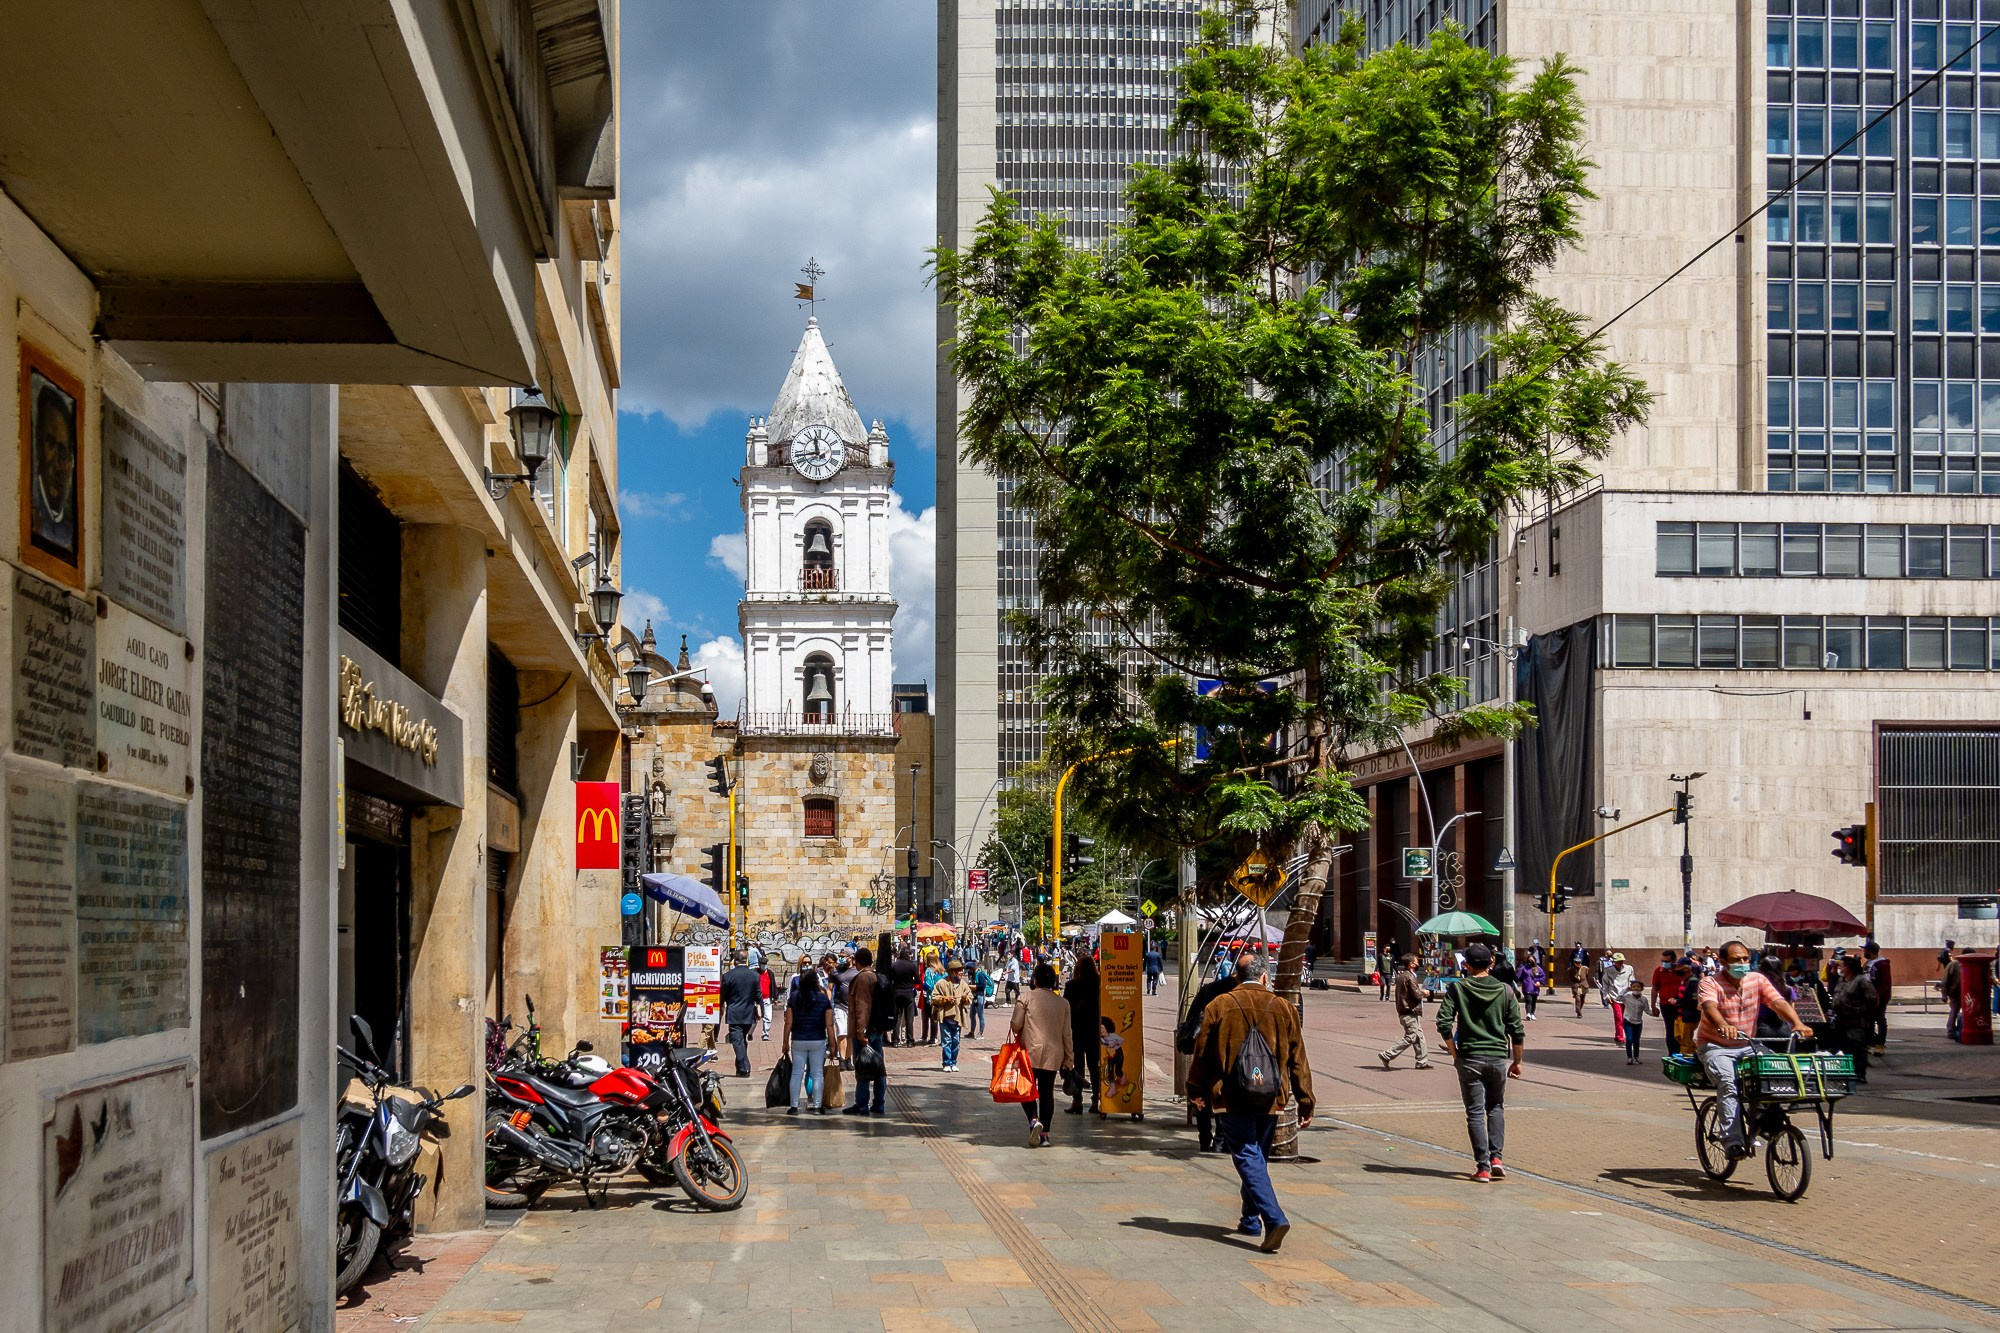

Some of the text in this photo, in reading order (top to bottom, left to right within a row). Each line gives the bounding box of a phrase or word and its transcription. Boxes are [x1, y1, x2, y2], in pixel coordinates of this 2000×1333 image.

[126, 637, 168, 669] AQUI CAYO
[99, 658, 128, 693] JORGE
[131, 671, 164, 707] ELIECER
[167, 686, 191, 718] GAITAN
[101, 701, 135, 728] CAUDILLO
[141, 715, 155, 735] DEL
[160, 722, 189, 747] PUEBLO
[127, 744, 130, 755] 9
[138, 748, 151, 763] ABRIL
[1371, 759, 1382, 774] DE
[1387, 756, 1399, 769] LA
[673, 893, 688, 903] TIEMPO
[687, 952, 706, 960] Pide
[687, 959, 715, 967] y Pasa
